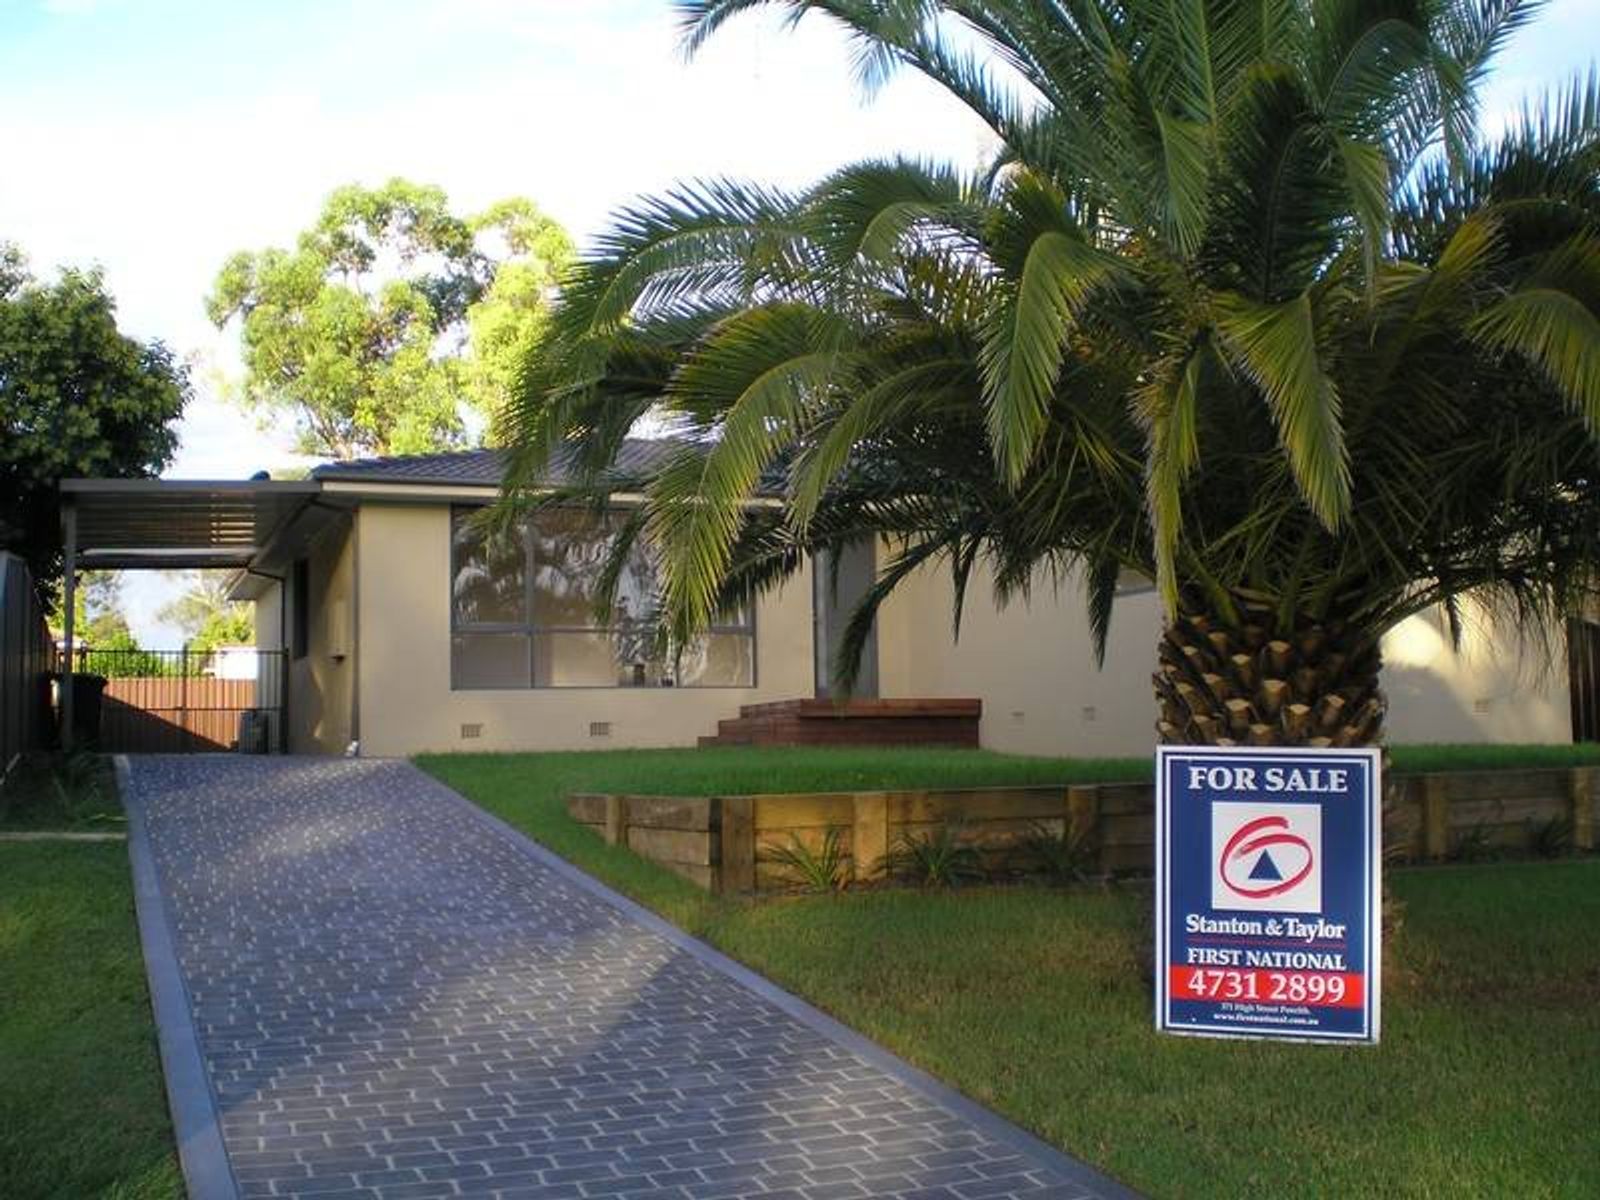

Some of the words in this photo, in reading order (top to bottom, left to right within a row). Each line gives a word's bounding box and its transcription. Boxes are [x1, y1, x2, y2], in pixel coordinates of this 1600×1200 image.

[1188, 766, 1257, 790] FOR
[1265, 768, 1348, 792] SALE
[1186, 914, 1262, 936] Stanton
[1265, 918, 1283, 936] &
[1284, 918, 1346, 943] Taylor
[1187, 948, 1243, 966] FIRST
[1246, 951, 1347, 970] NATIONAL
[1188, 970, 1259, 999] 4731
[1269, 973, 1346, 1003] 2899
[1235, 1003, 1255, 1013] High
